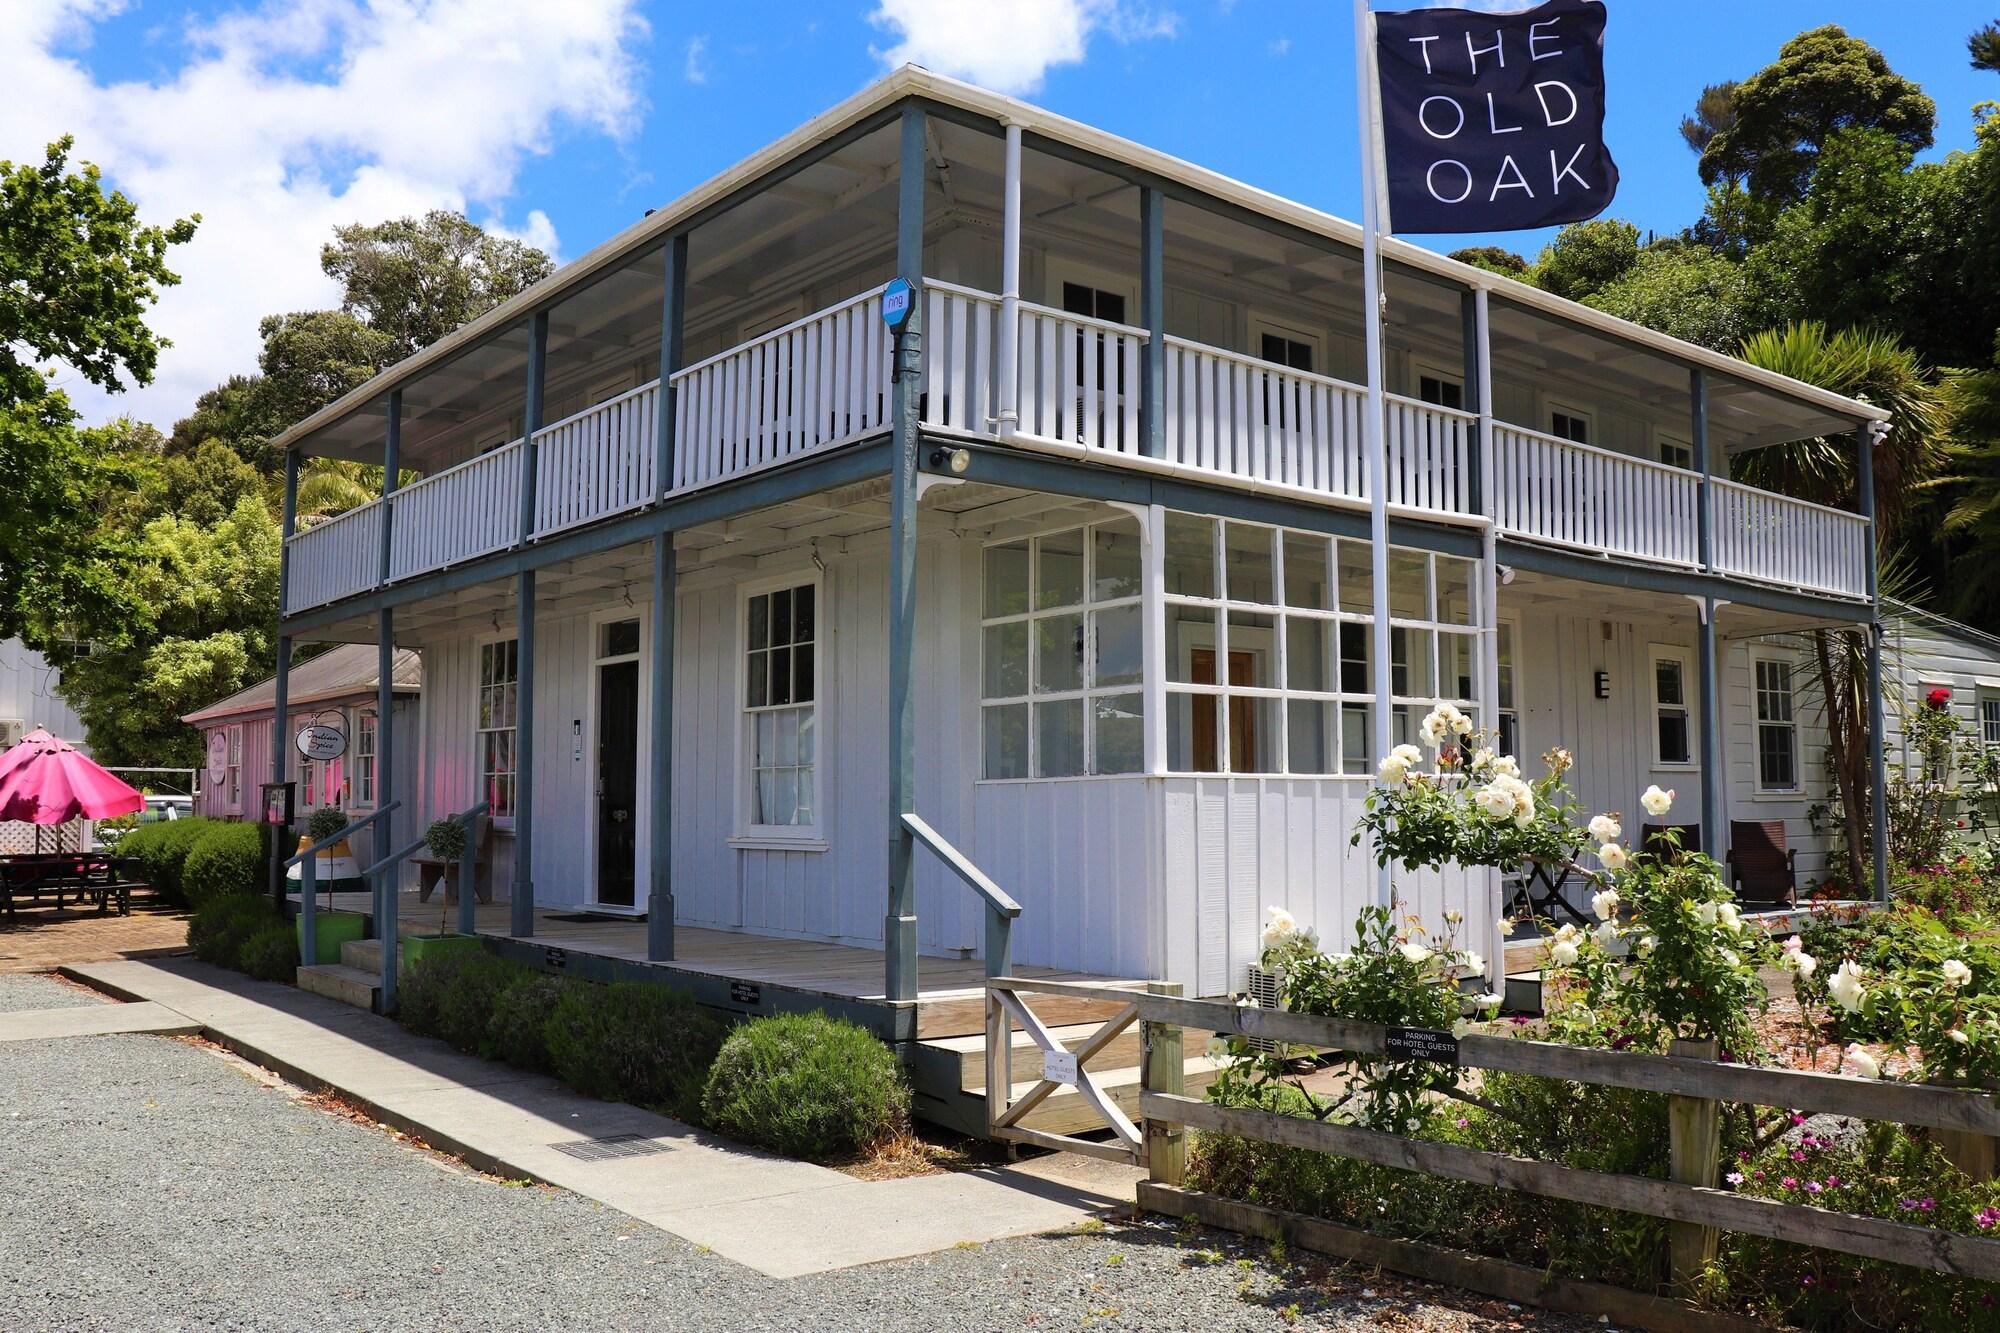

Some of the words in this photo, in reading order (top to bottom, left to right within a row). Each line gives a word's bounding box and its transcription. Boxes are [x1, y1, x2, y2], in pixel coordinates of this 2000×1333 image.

[1408, 16, 1563, 75] THE
[1418, 80, 1578, 139] OLD
[1426, 143, 1591, 204] OAK
[888, 295, 903, 308] ring
[307, 730, 338, 741] Indian
[309, 739, 334, 750] Spice
[1405, 1031, 1437, 1042] PARKING
[1387, 1038, 1402, 1046] FOR
[1403, 1040, 1426, 1049] HOTEL
[1427, 1042, 1456, 1052] GUESTS
[1411, 1048, 1431, 1057] ONLY
